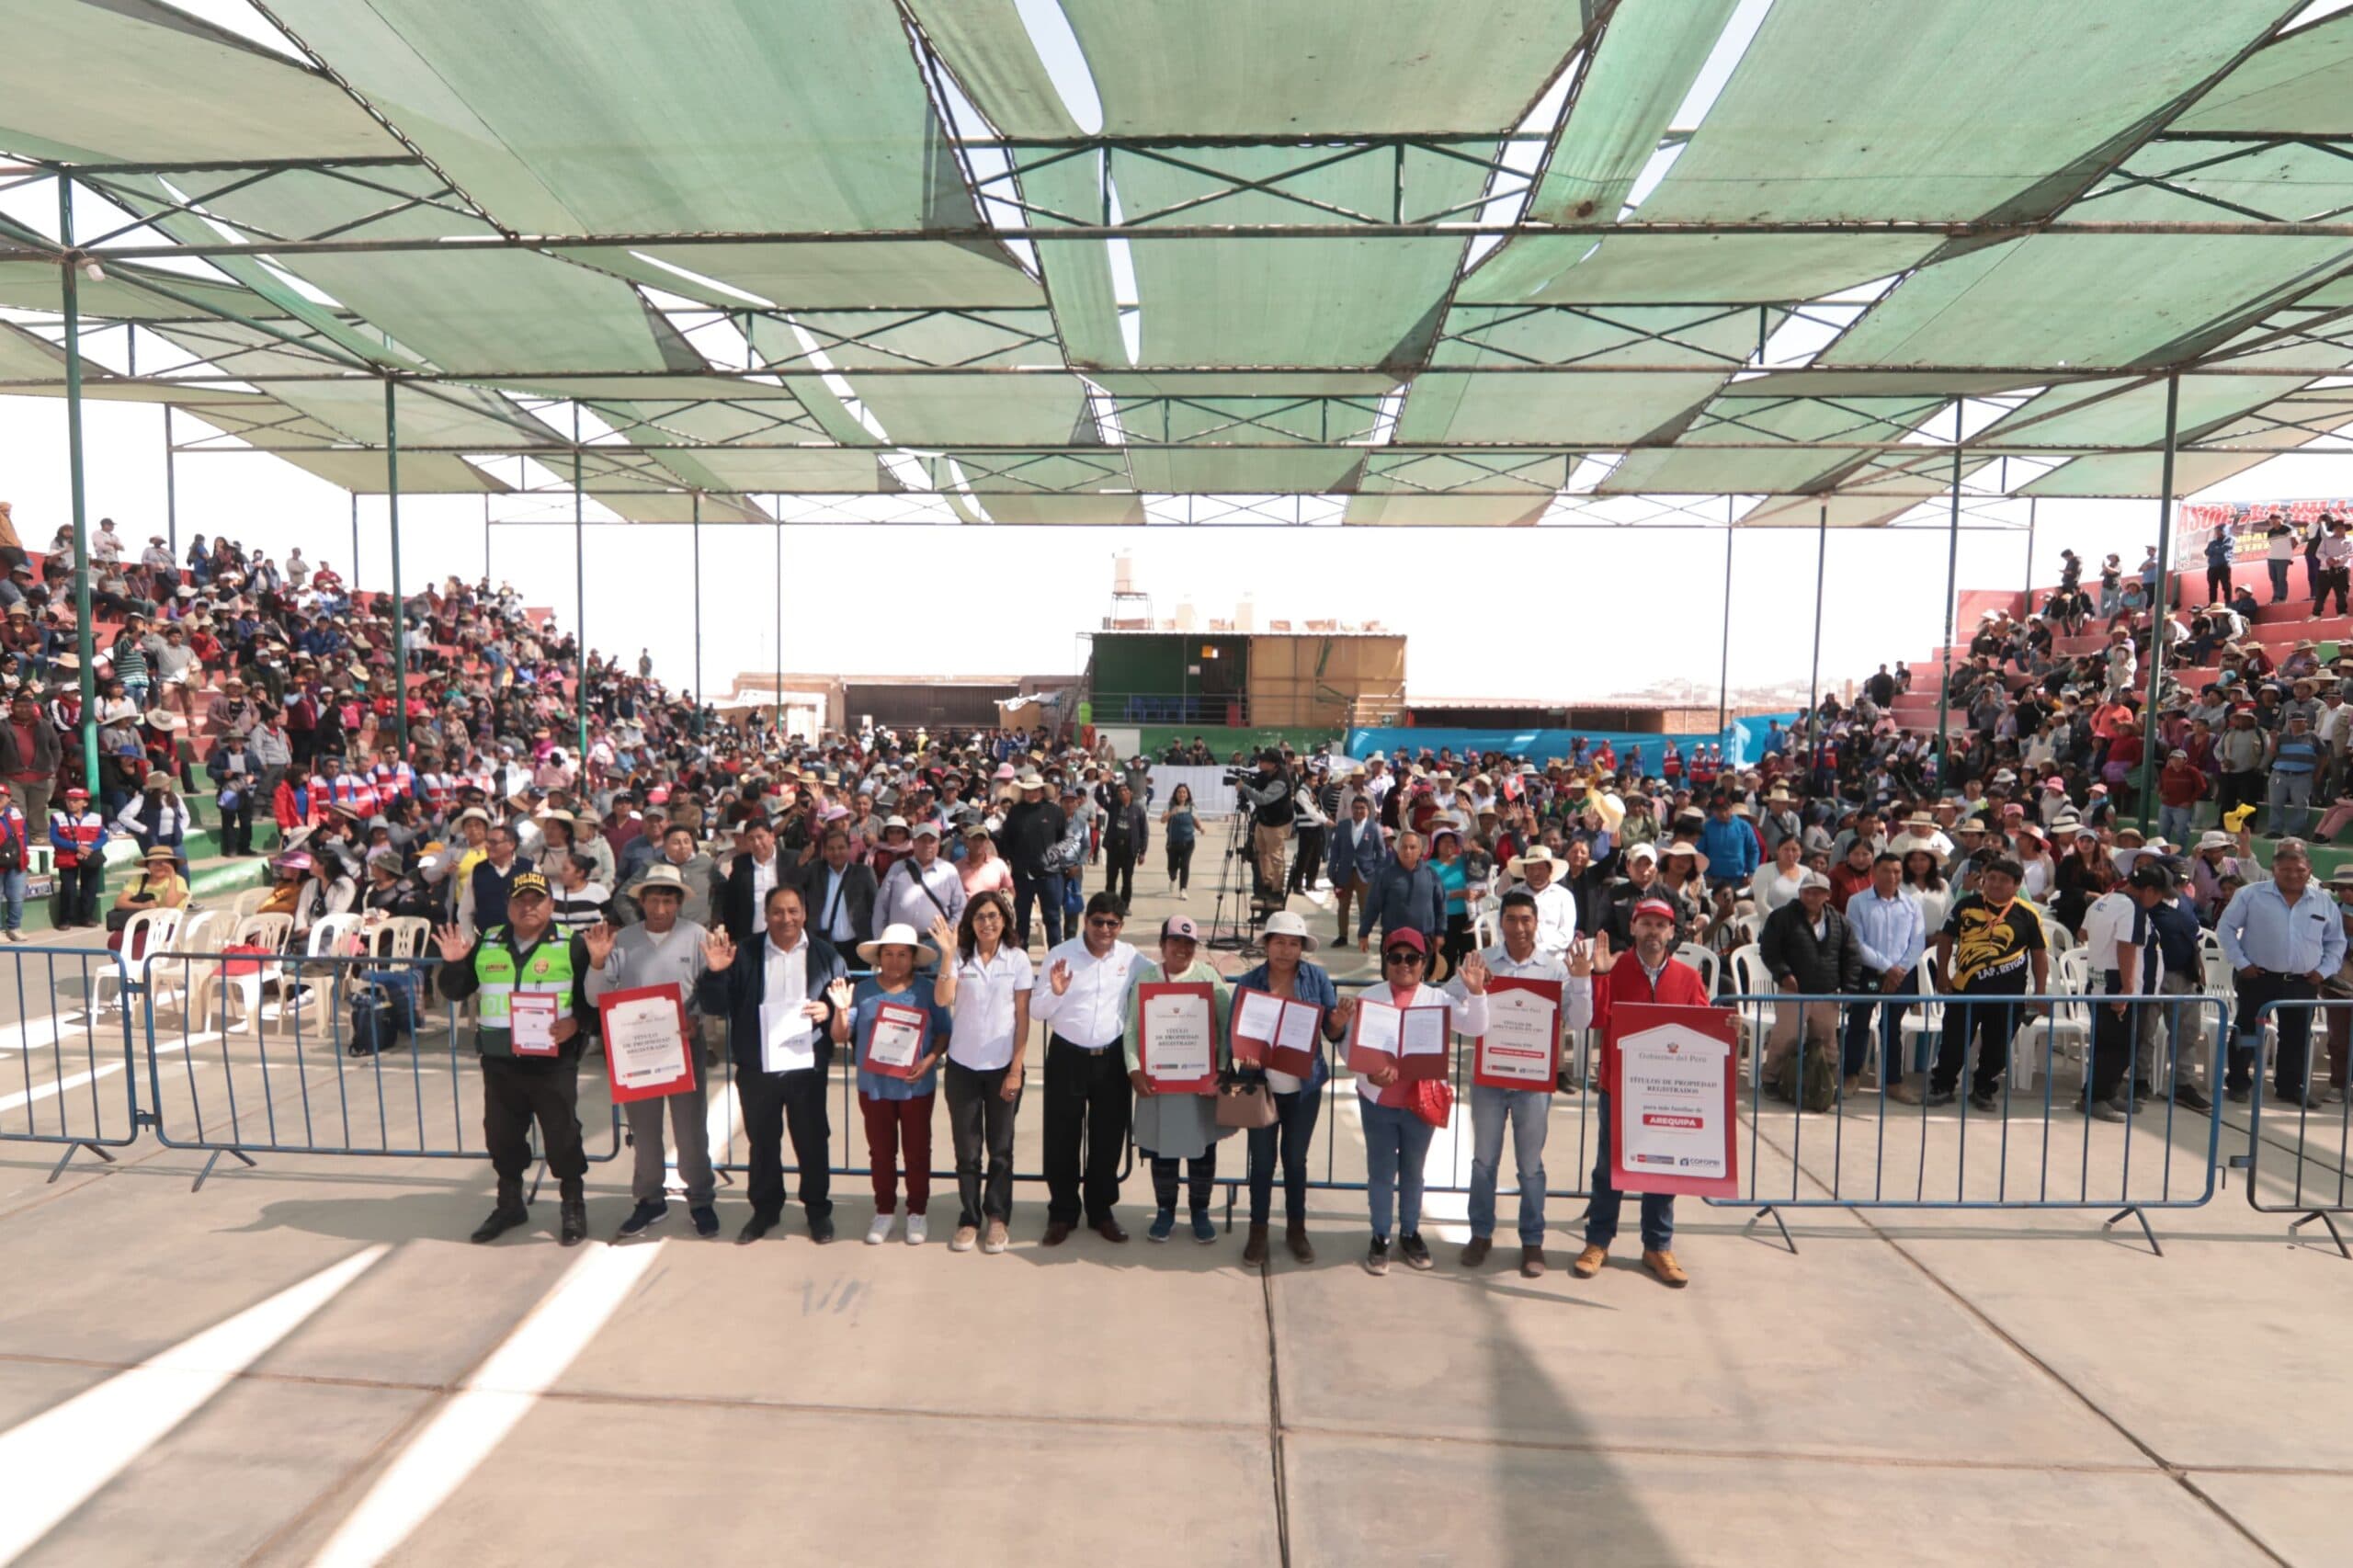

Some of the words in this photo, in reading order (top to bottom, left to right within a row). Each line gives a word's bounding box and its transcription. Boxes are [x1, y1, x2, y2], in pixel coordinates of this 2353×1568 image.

[514, 872, 545, 888] POLICIA
[1675, 1079, 1718, 1088] PROPIEDAD
[1649, 1117, 1697, 1127] AREQUIPA
